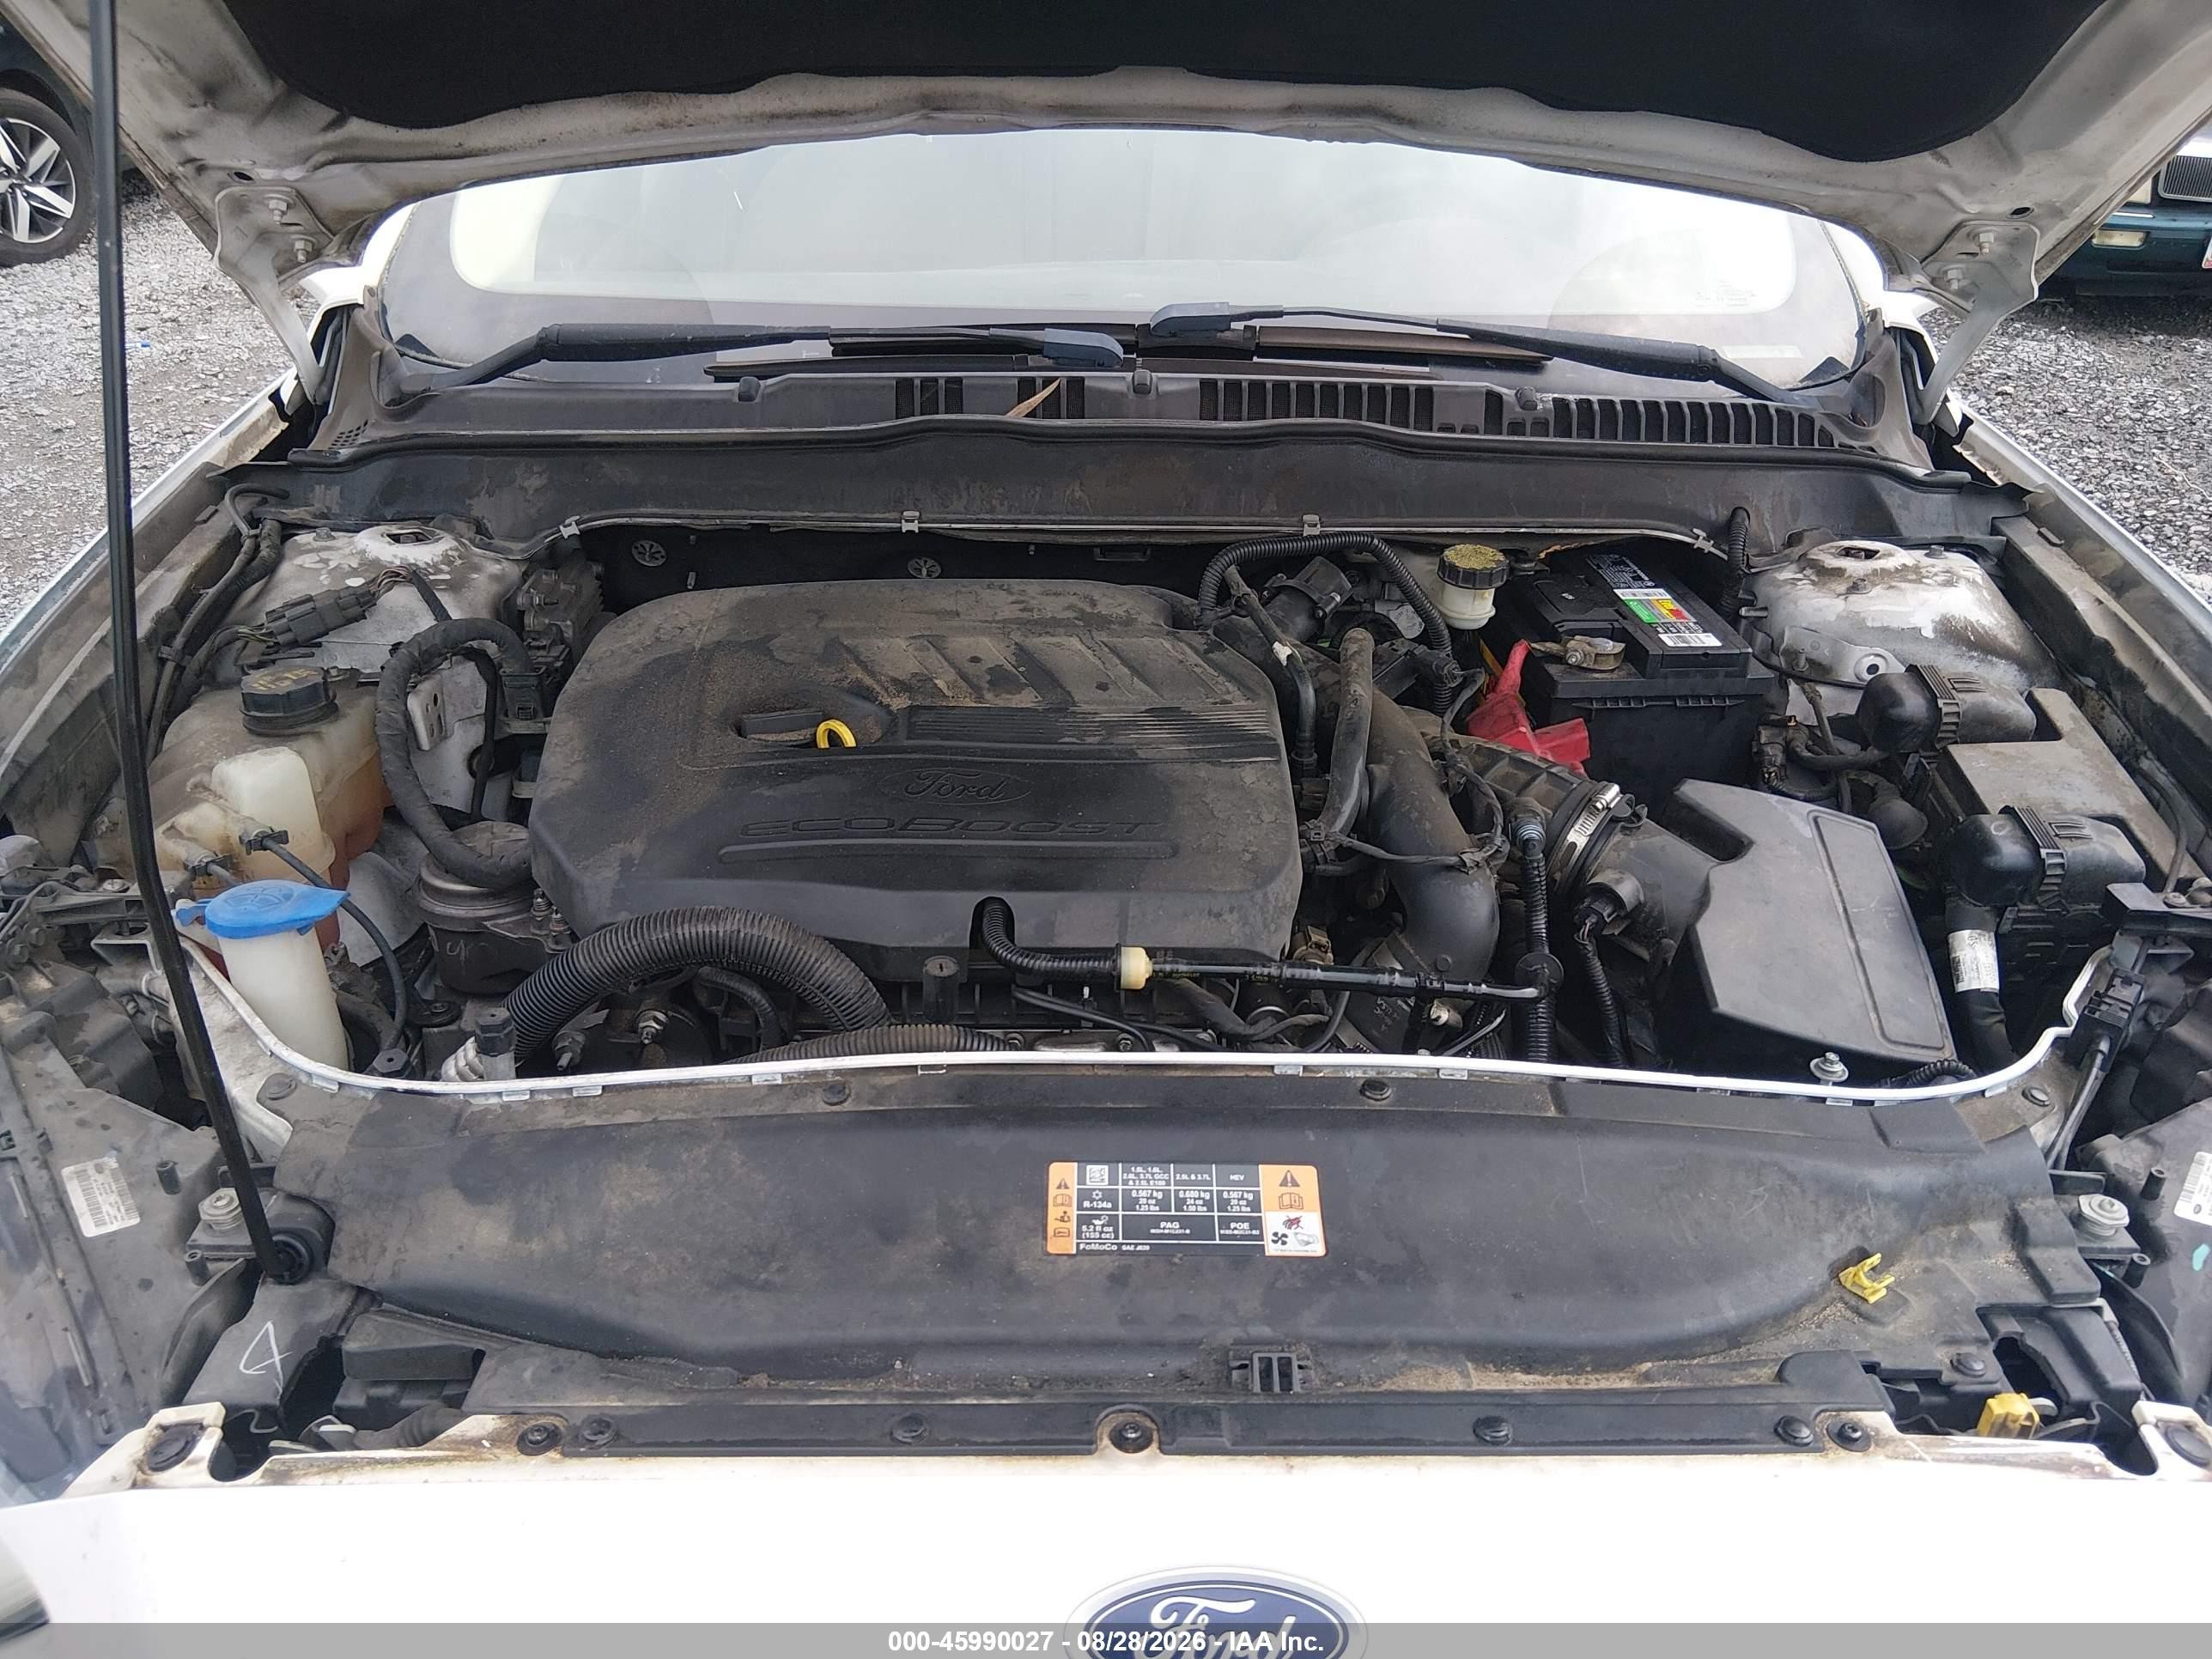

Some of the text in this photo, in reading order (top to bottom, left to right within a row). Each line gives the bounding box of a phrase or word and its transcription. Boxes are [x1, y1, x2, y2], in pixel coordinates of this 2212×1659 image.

[903, 769, 1010, 801] Ford
[1200, 1190, 1210, 1200] kg
[1243, 1190, 1254, 1200] kg
[1083, 1200, 1112, 1209] R-134a
[1079, 1243, 1118, 1251] FoMoCo
[1133, 1595, 1297, 1659] Ford
